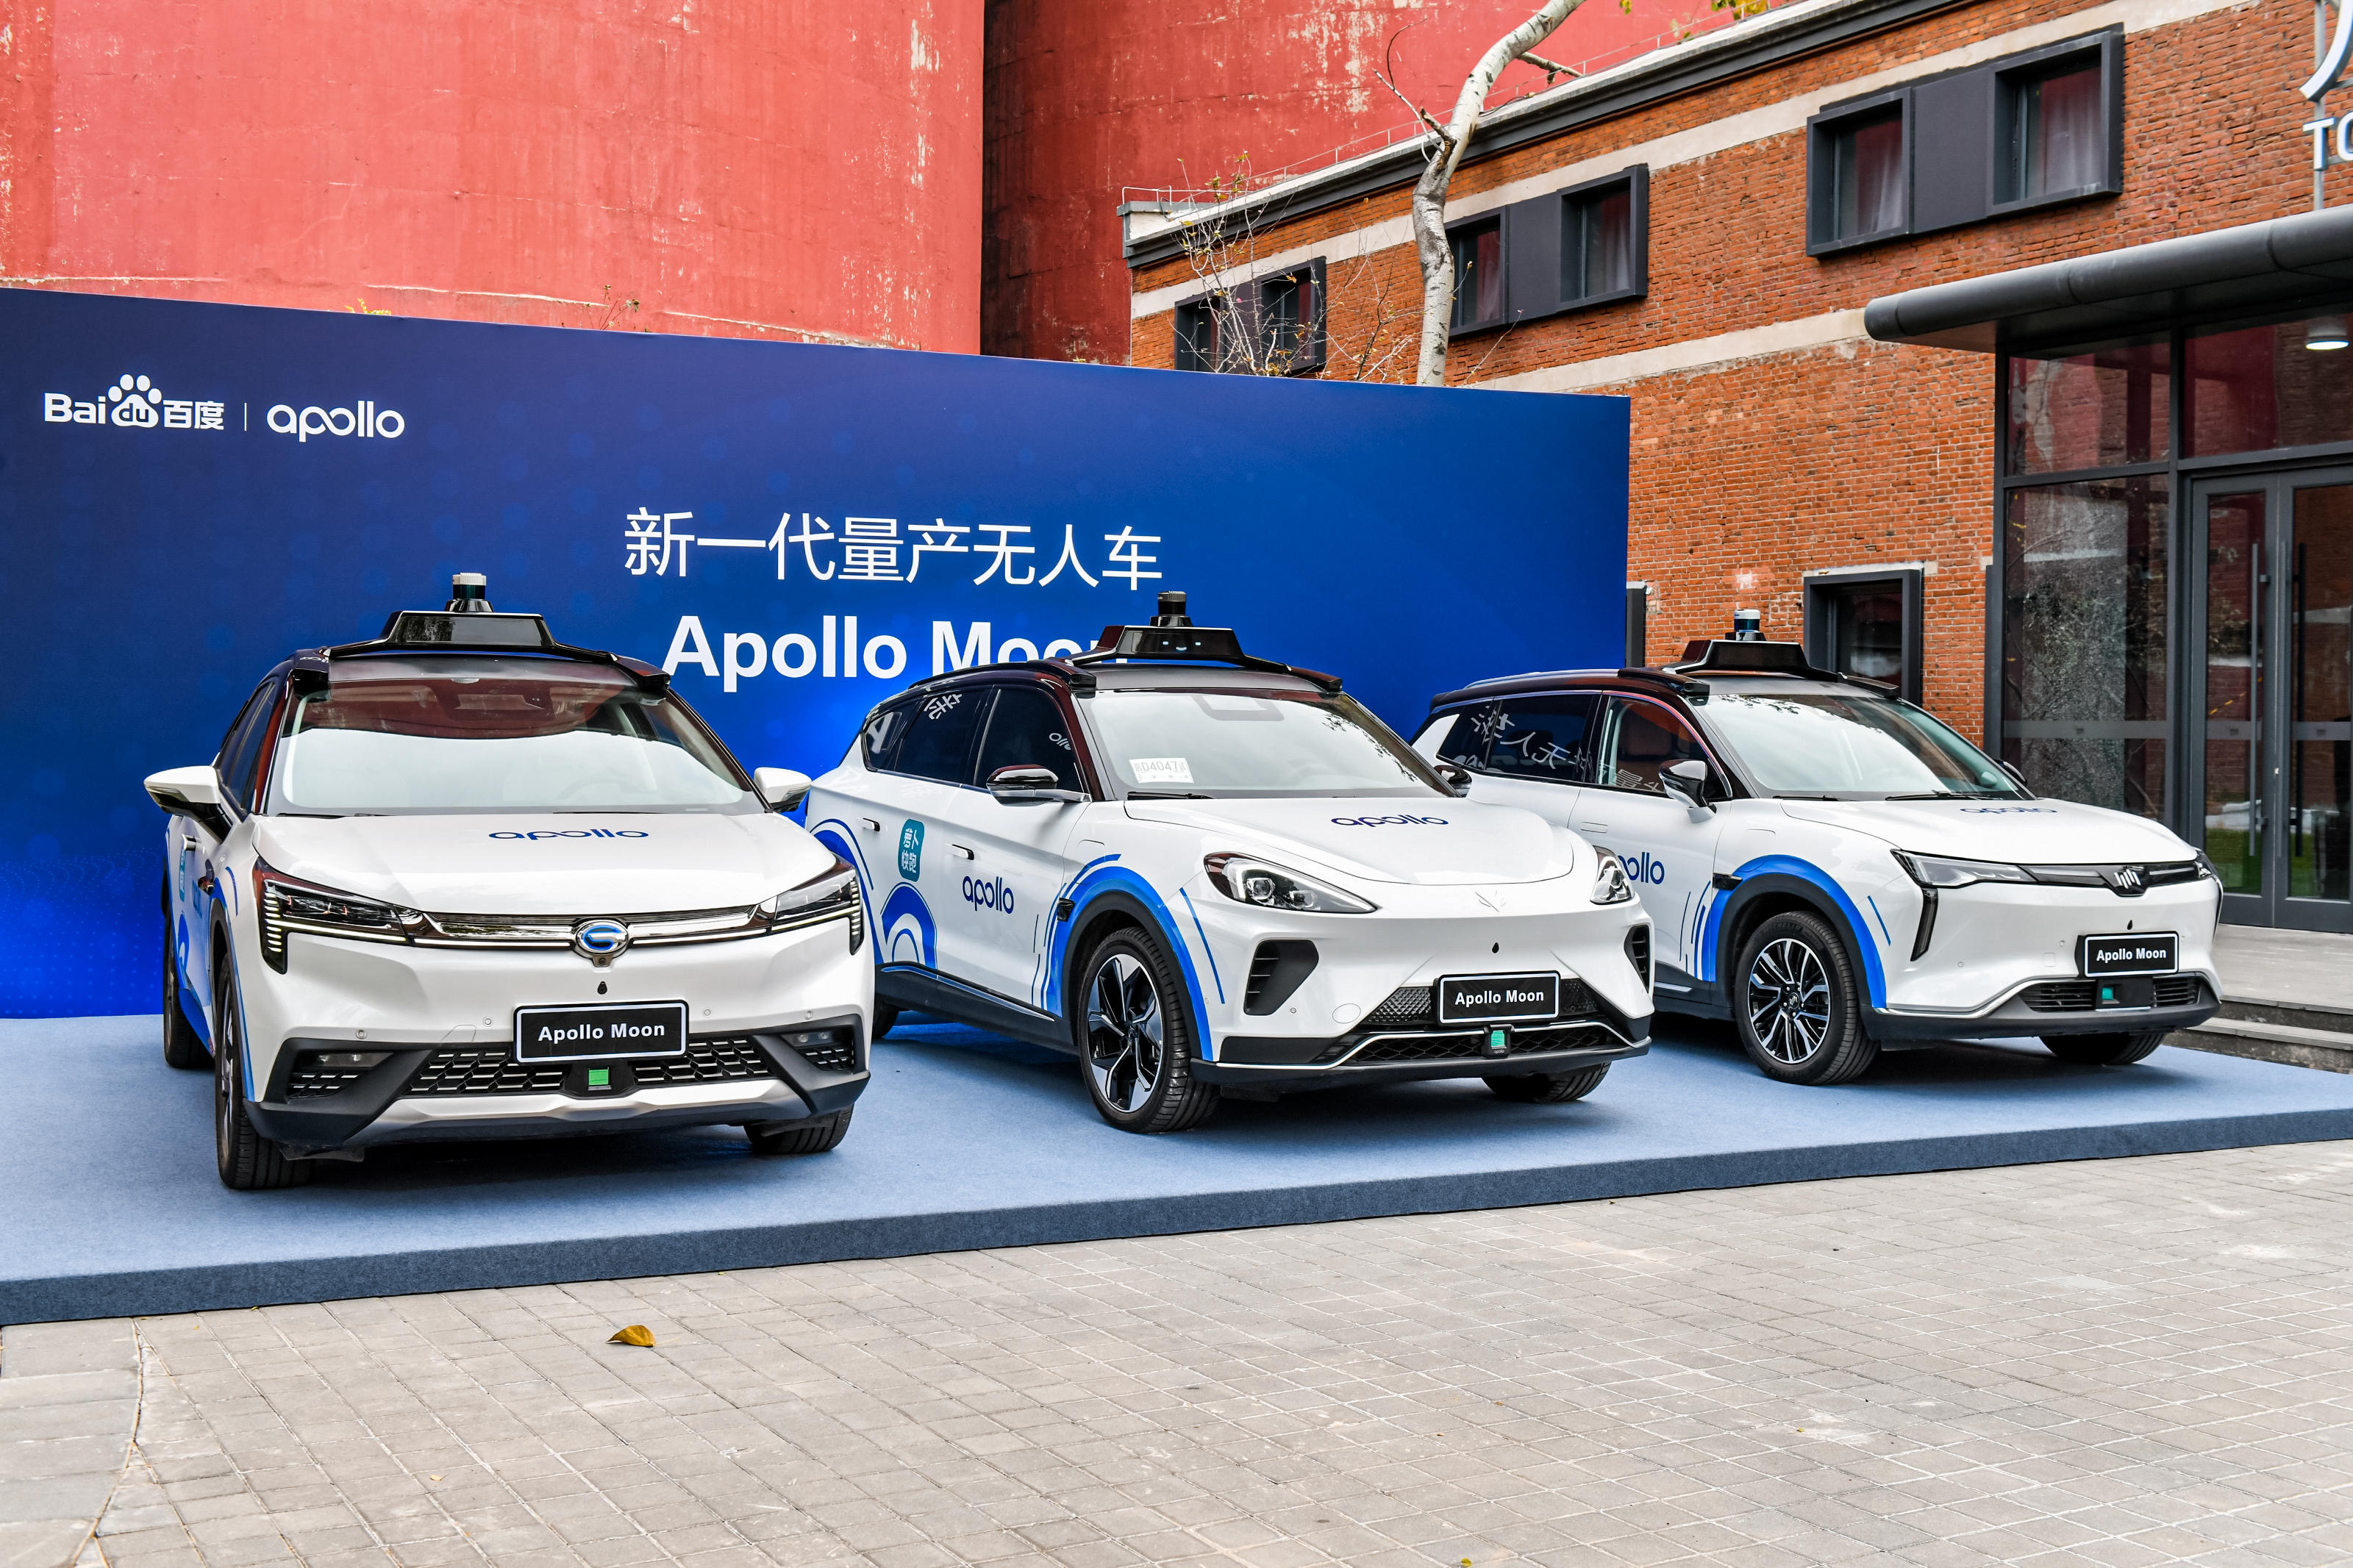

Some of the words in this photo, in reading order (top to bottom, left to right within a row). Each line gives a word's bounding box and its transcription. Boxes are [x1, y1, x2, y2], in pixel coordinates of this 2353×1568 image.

[267, 401, 405, 442] apollo
[624, 507, 1163, 590] 新一代量产无人车
[663, 615, 907, 692] Apollo
[932, 621, 1128, 674] Mo
[488, 828, 649, 841] apollo
[1331, 815, 1449, 828] apollo
[1618, 851, 1665, 885] ollo
[962, 876, 1015, 914] apollo
[2096, 948, 2133, 964] Apollo
[2135, 948, 2167, 960] Moon
[1454, 990, 1502, 1008] Apollo
[1506, 989, 1544, 1003] Moon
[538, 1024, 604, 1045] Apollo
[610, 1023, 665, 1038] Moon
